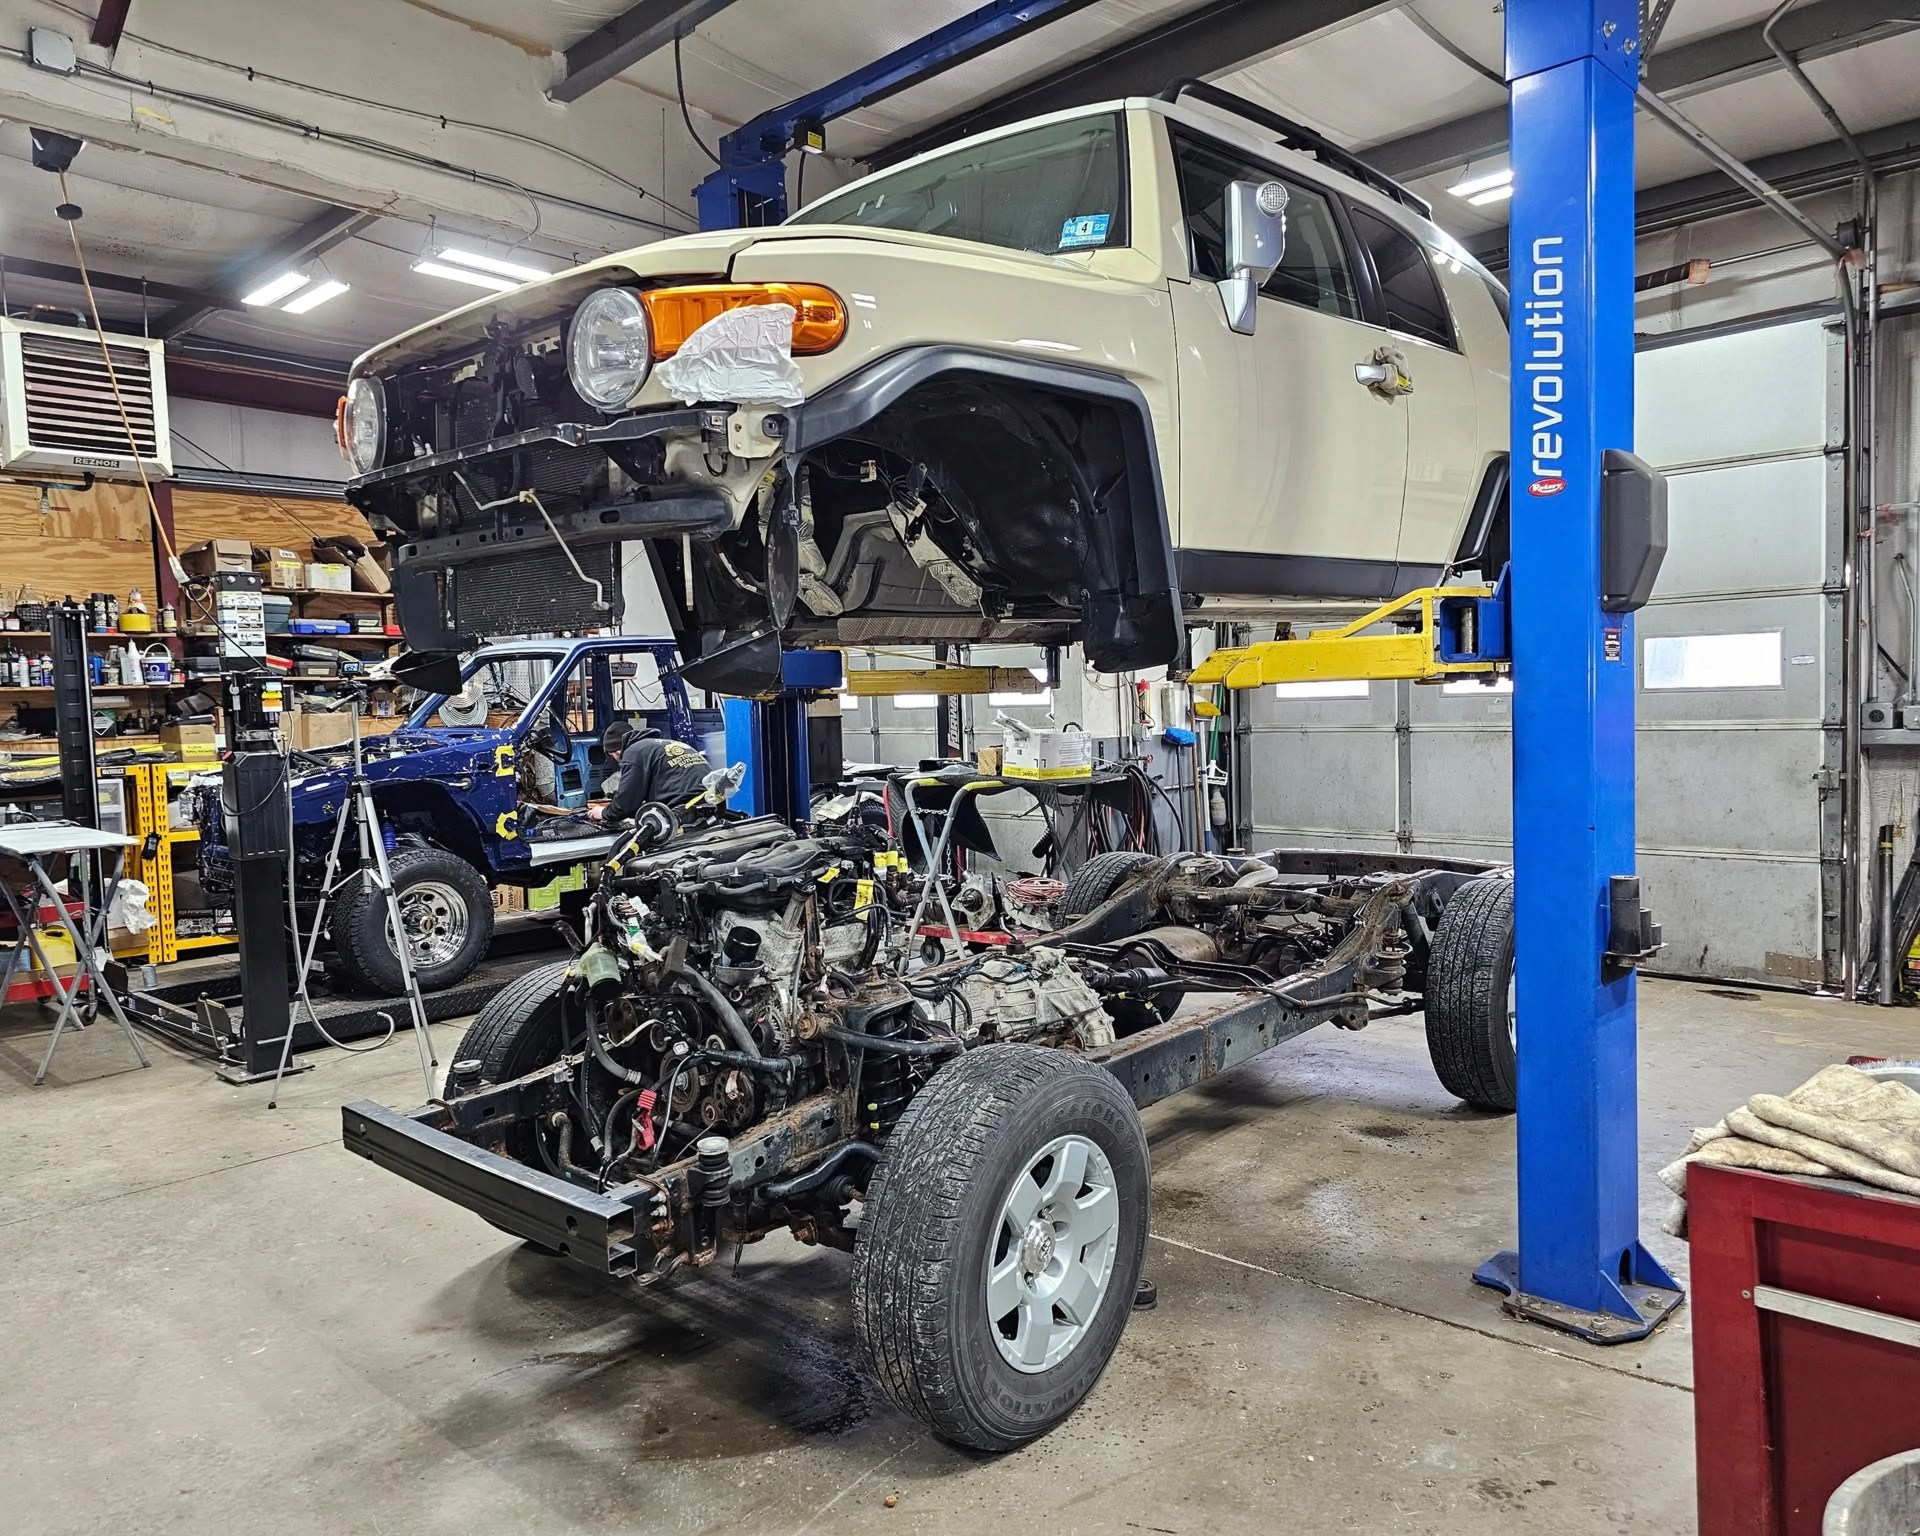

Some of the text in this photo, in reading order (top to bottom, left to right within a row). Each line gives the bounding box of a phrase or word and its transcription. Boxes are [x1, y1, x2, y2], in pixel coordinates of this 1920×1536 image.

[1081, 222, 1088, 233] 4
[1094, 223, 1105, 231] 22
[1525, 236, 1563, 477] revolution
[75, 457, 118, 468] REZNOR
